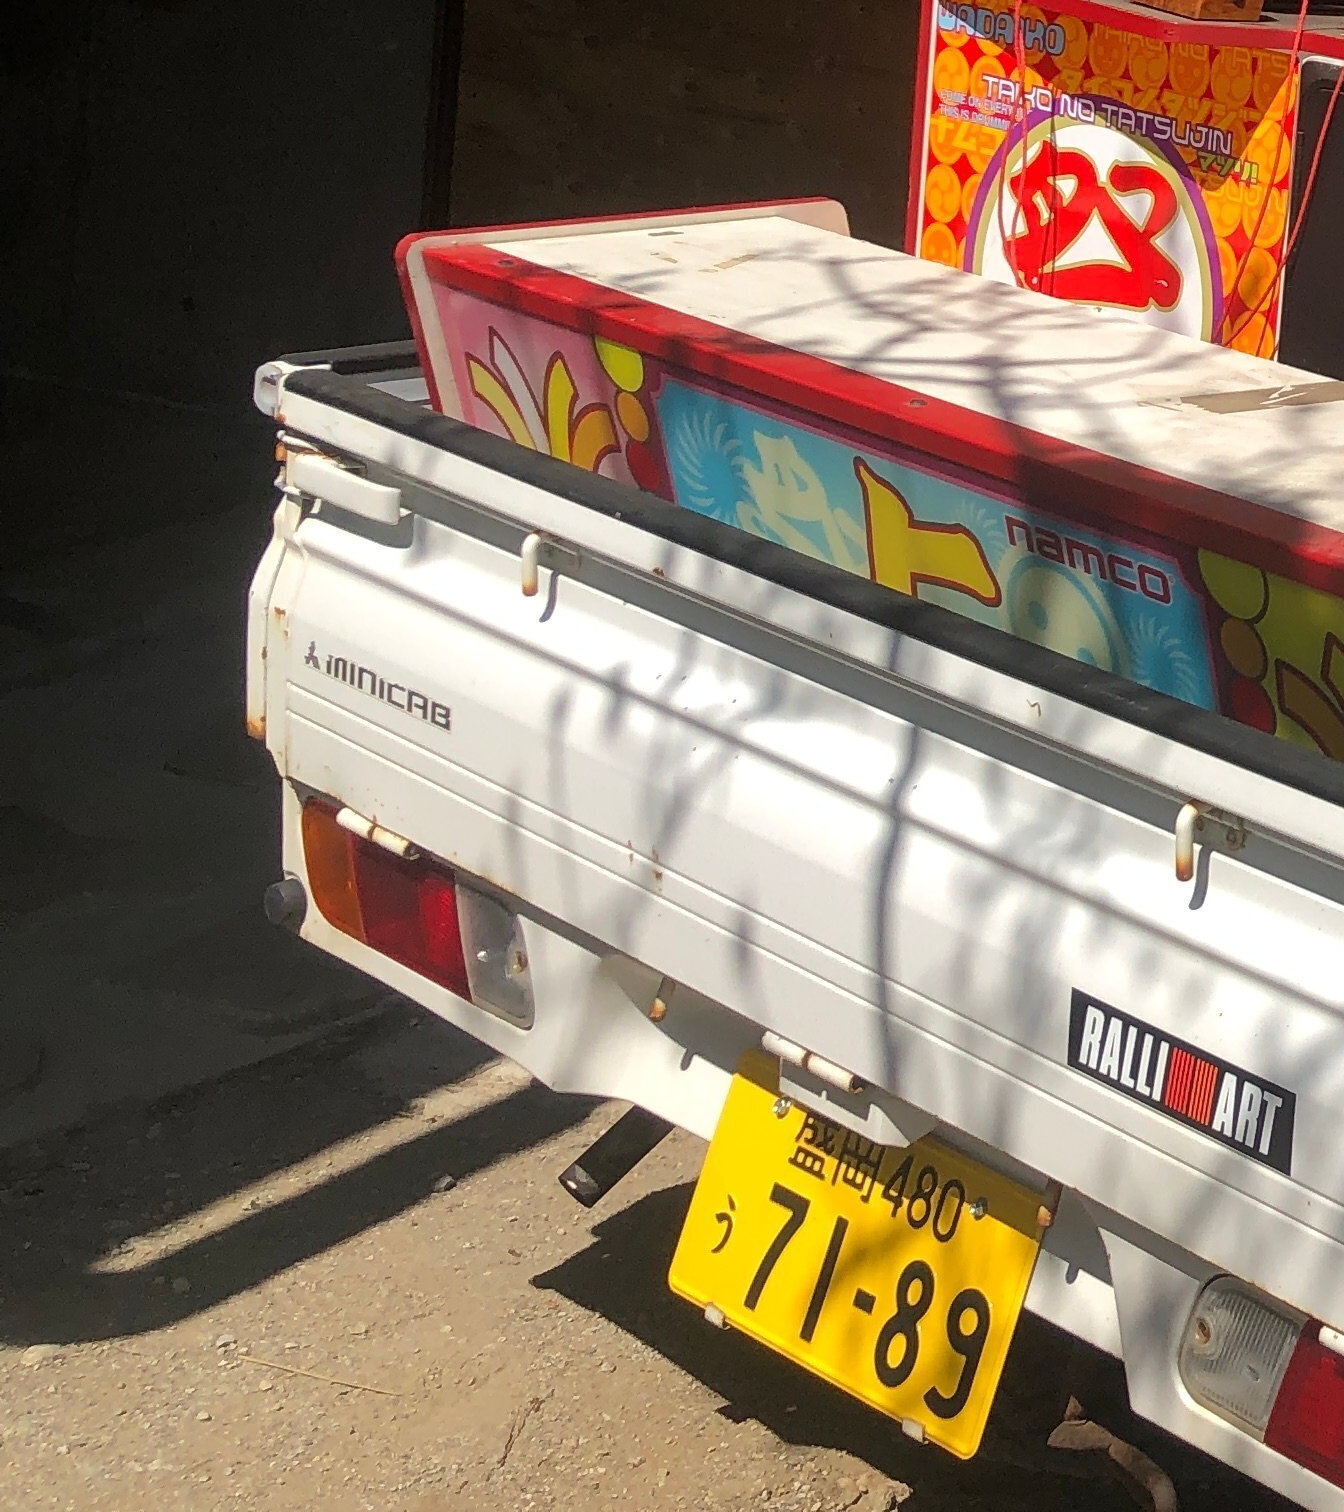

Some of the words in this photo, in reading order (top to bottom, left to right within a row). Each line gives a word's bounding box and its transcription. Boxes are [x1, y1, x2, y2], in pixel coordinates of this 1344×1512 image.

[1059, 93, 1095, 123] NO
[1100, 100, 1232, 156] TATSUJIN
[1004, 514, 1172, 605] namco
[326, 654, 451, 731] MINICAB
[1078, 1004, 1170, 1103] RALLI
[1211, 1071, 1283, 1156] ART
[881, 1153, 966, 1244] 480
[711, 1194, 736, 1254] う
[743, 1181, 991, 1419] 71-89
